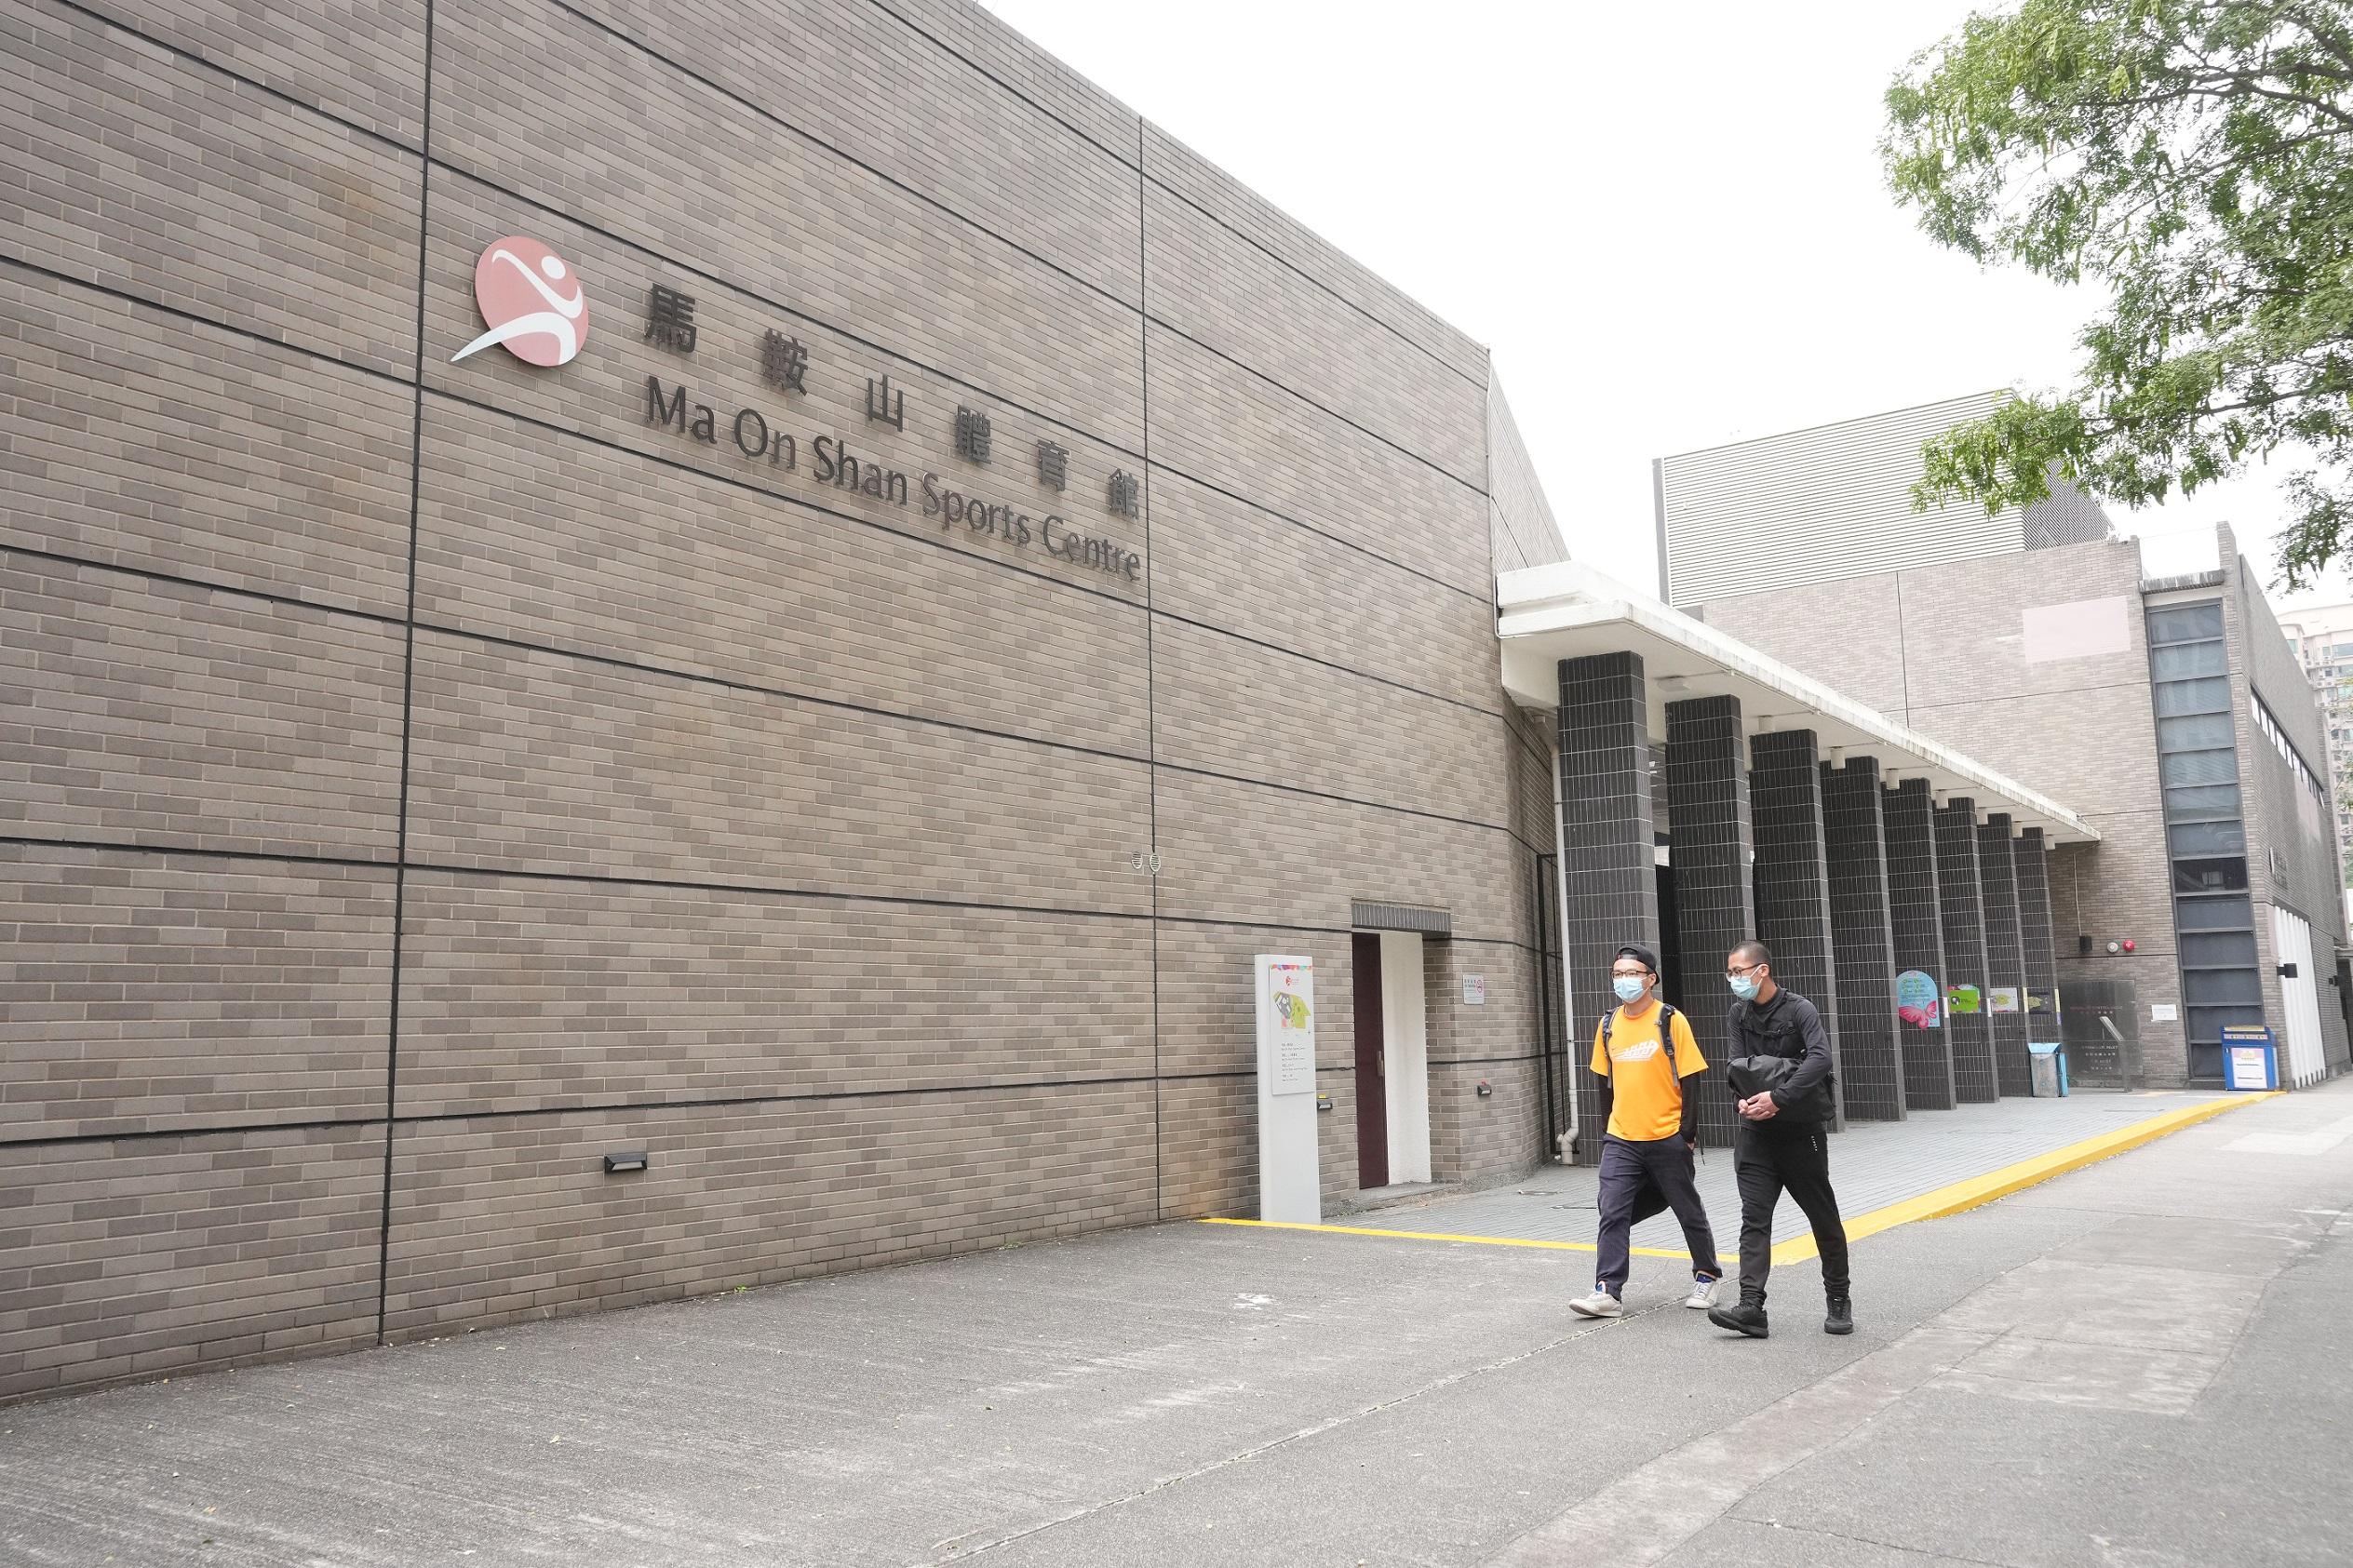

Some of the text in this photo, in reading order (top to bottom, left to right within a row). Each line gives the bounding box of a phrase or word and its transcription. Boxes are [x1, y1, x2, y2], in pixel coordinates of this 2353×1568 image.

[644, 283, 1139, 520] 馬鞍山體育館
[646, 375, 1140, 581] Ma On Shan Sports Centre
